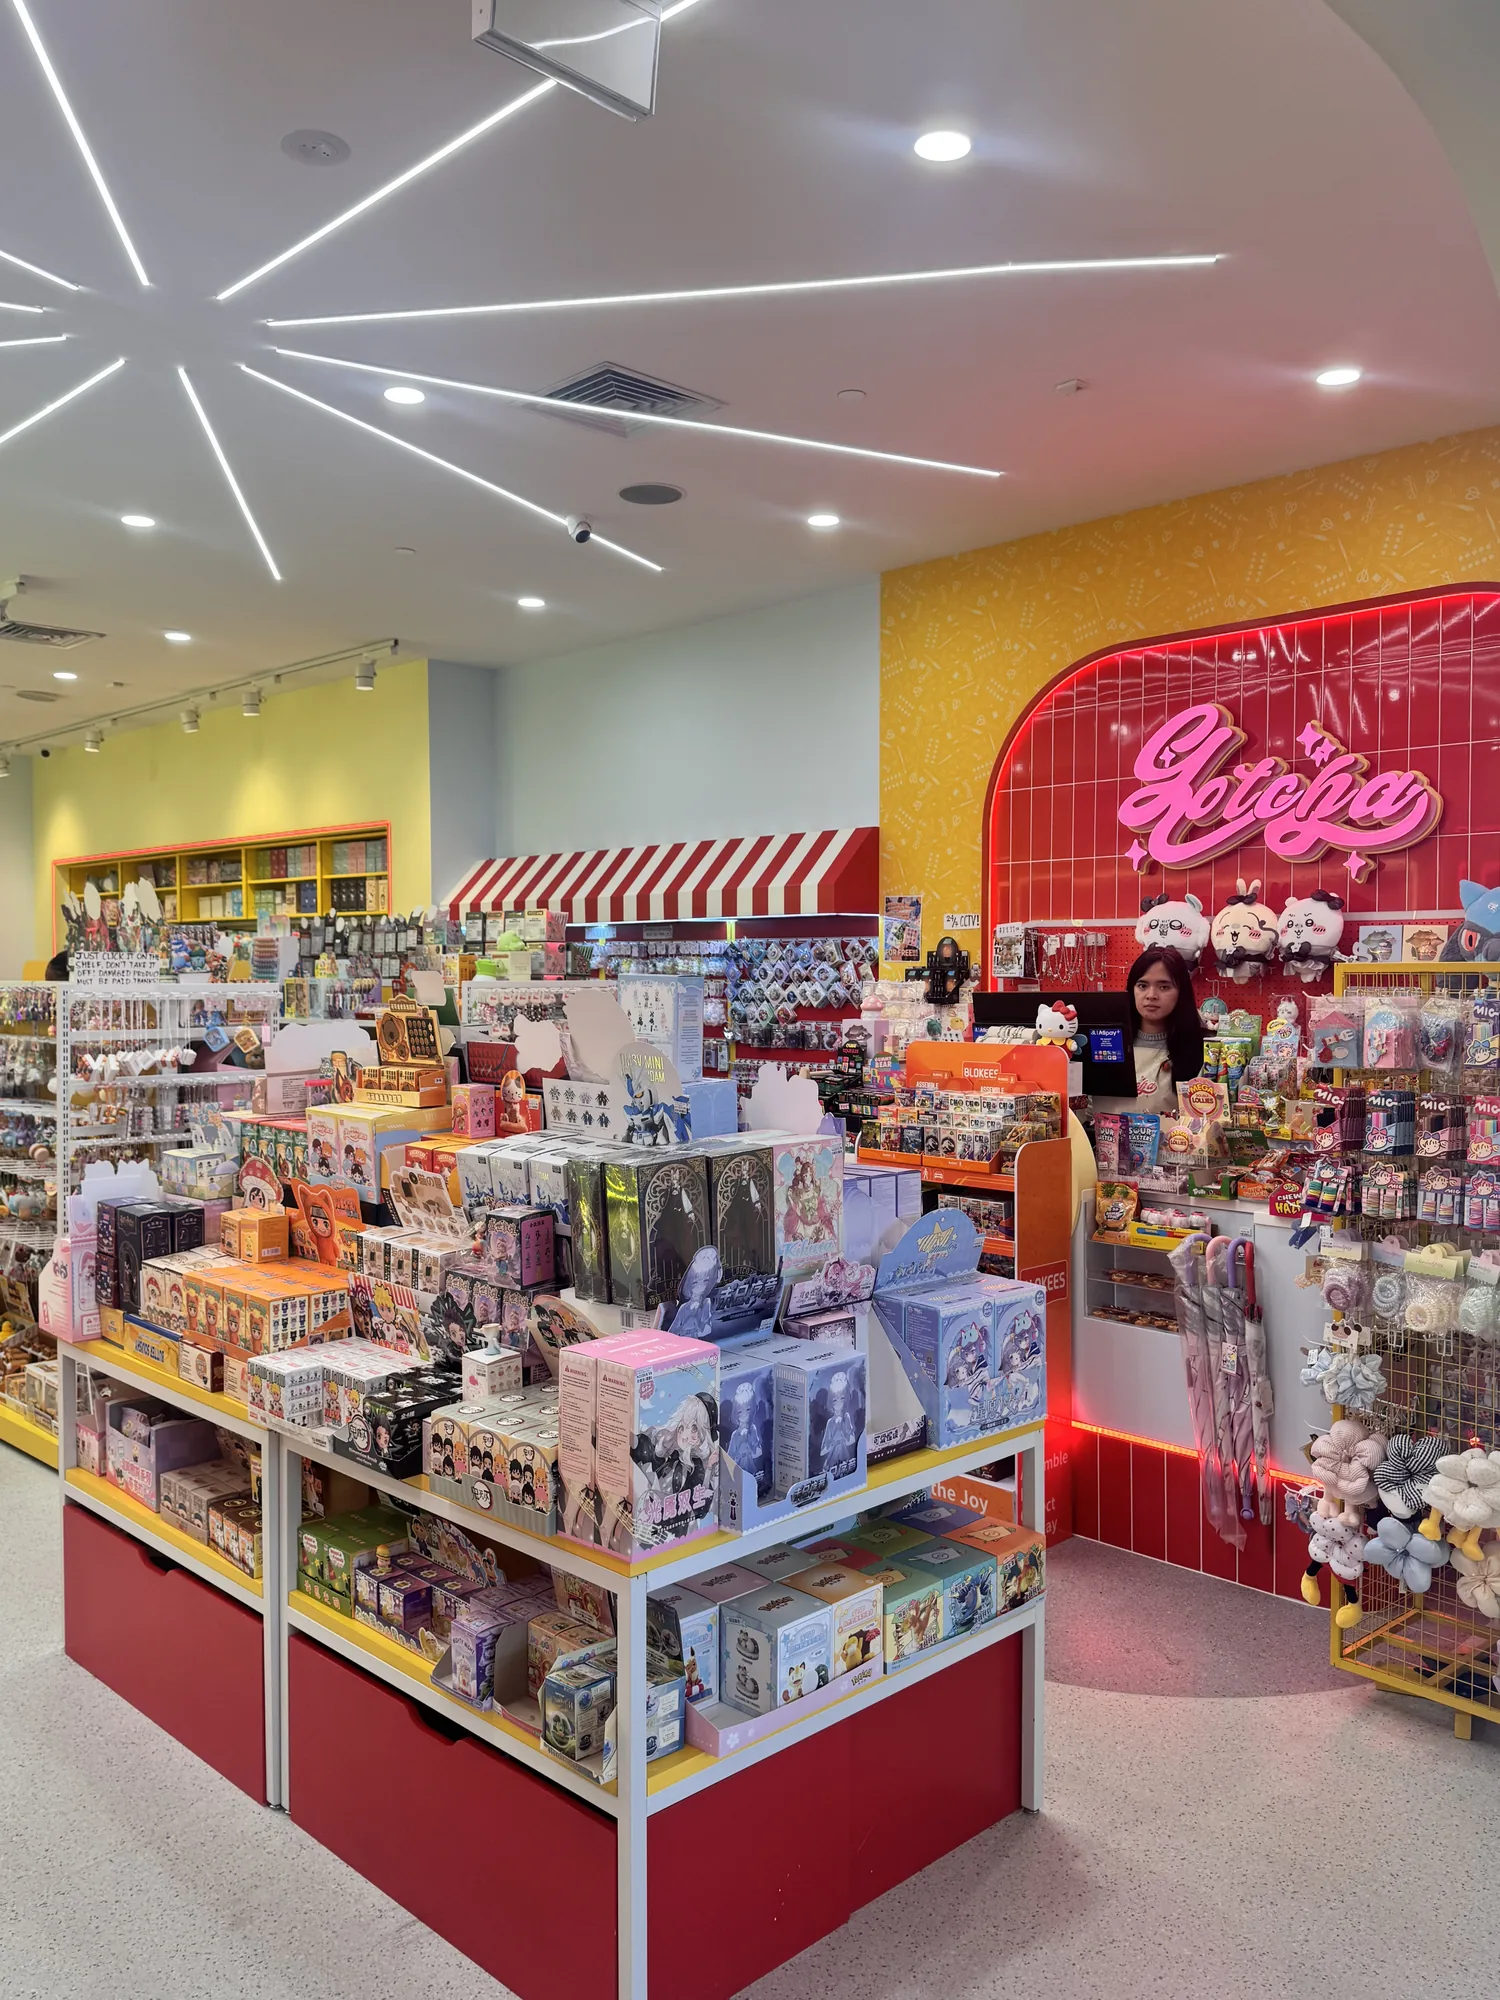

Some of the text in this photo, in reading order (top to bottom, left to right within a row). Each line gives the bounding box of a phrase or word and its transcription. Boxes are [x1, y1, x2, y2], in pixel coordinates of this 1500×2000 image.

[1118, 703, 1437, 867] Gotcha
[960, 914, 980, 927] CCTV!
[76, 952, 98, 960] JUST
[102, 952, 124, 960] CLICK
[127, 952, 134, 960] IT
[137, 953, 147, 961] ON
[106, 961, 126, 969] DON'T
[129, 961, 146, 969] TAKE
[1189, 1083, 1214, 1095] MEGA
[1023, 1270, 1066, 1293] OKEES
[931, 1482, 989, 1514] the Joy
